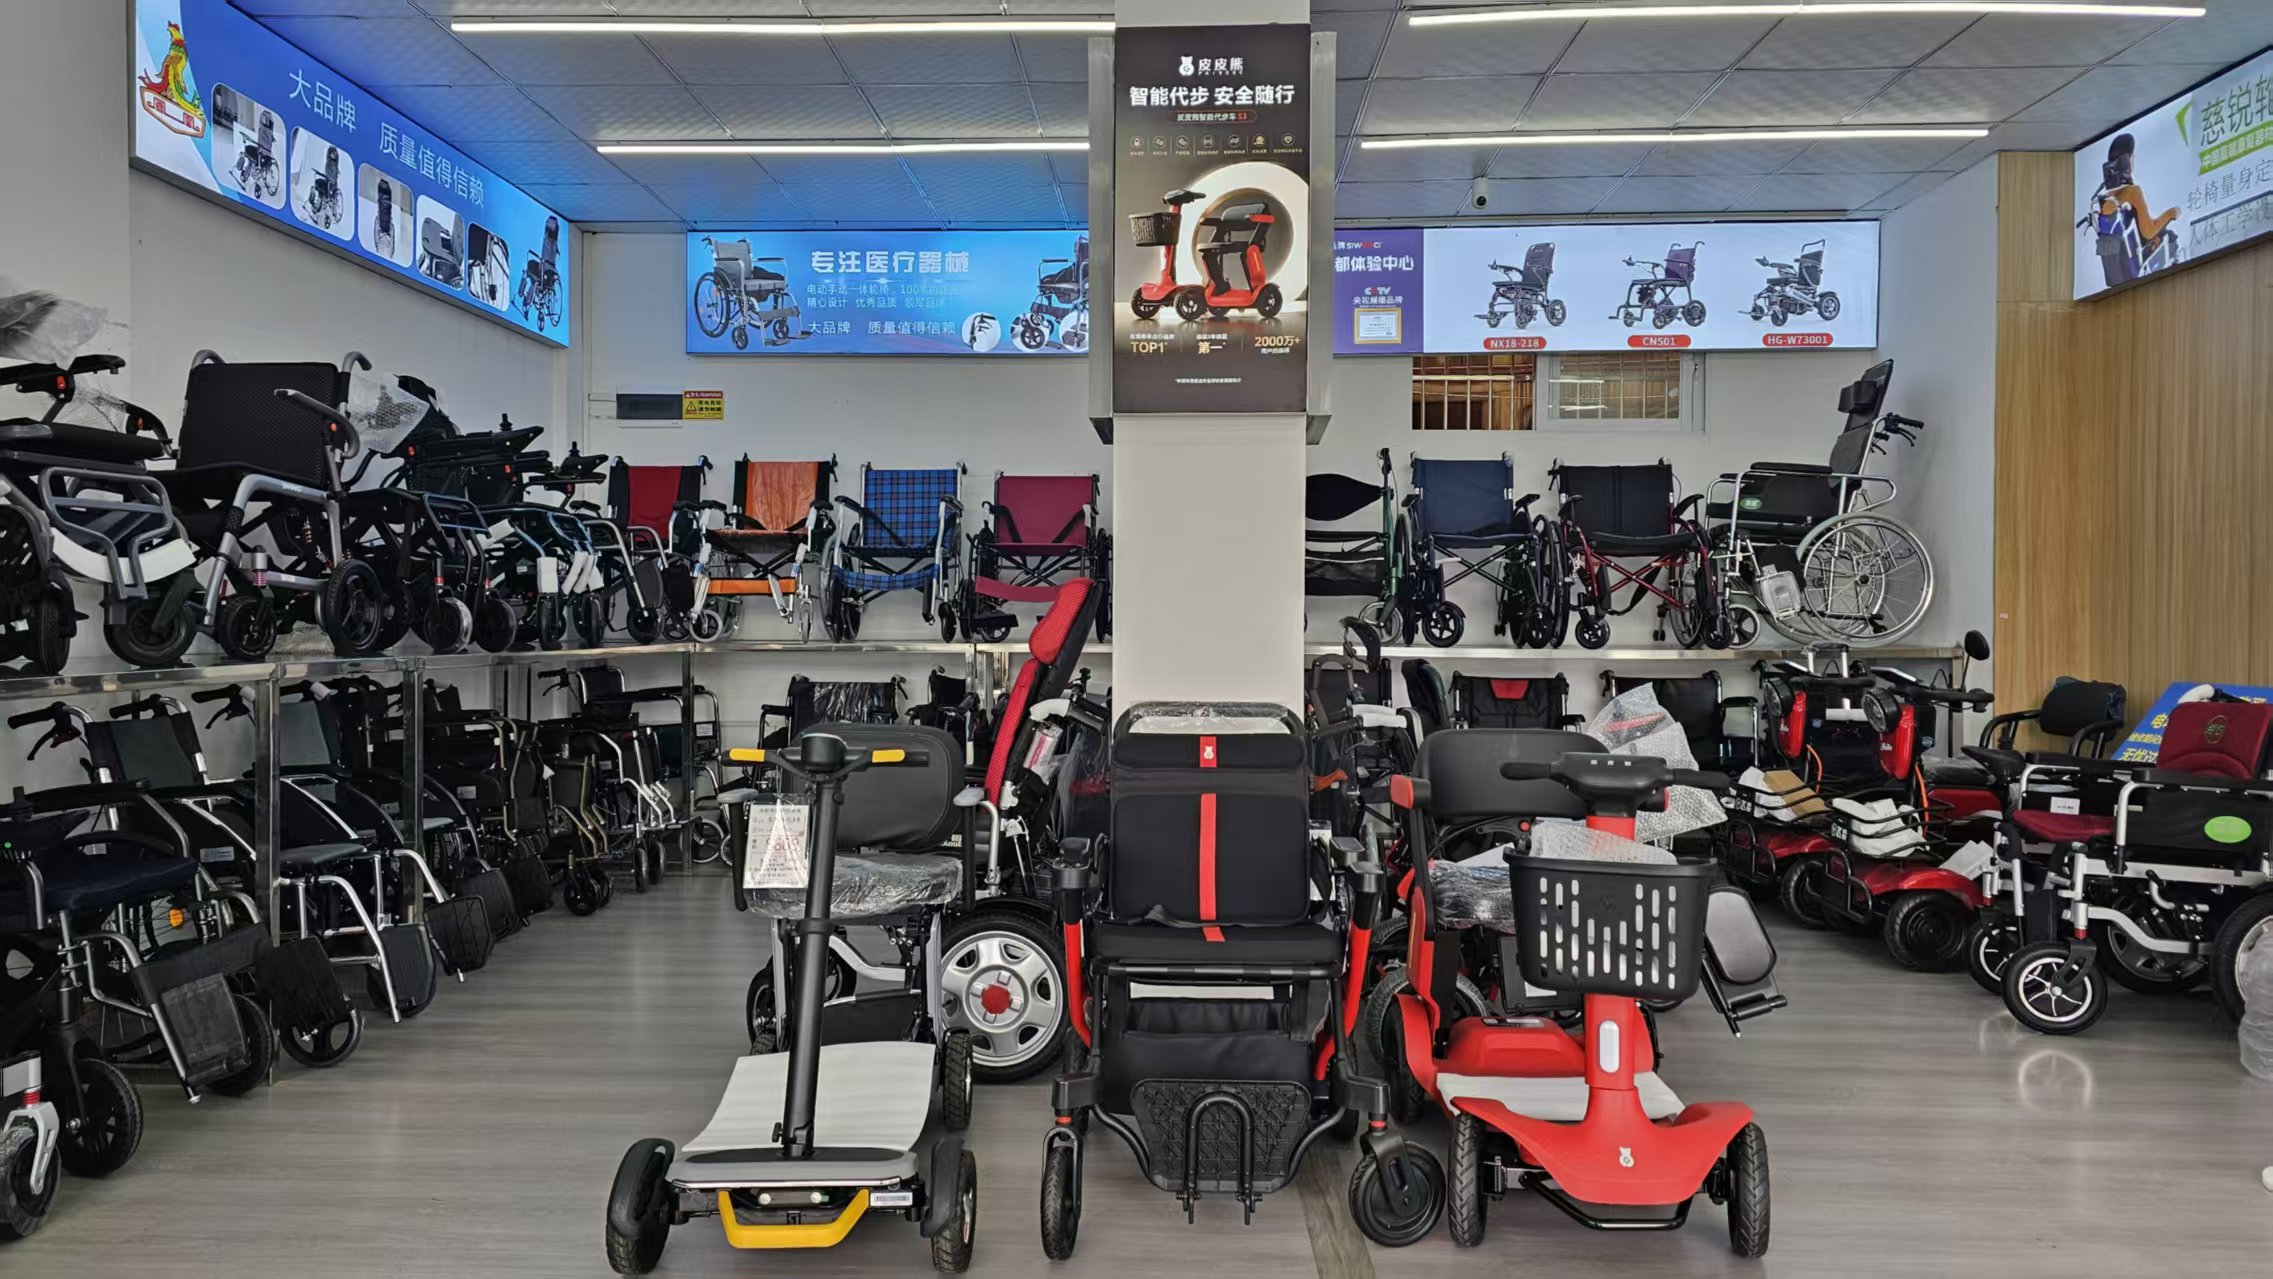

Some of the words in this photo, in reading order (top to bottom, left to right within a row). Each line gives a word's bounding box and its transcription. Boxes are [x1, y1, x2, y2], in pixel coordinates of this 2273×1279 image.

[1198, 57, 1244, 71] 皮皮熊
[1129, 86, 1210, 107] 智能代步
[1214, 84, 1296, 106] 安全随行
[288, 69, 358, 134] 大品牌
[379, 121, 485, 209] 质量值得信赖
[811, 250, 970, 273] 专注医疗器械
[1334, 255, 1415, 272] 都体验中心
[807, 298, 848, 308] 精心设计
[808, 321, 851, 335] 大品牌
[868, 321, 956, 335] 质量值得信赖
[1254, 335, 1301, 347] 2000万+
[1491, 339, 1540, 348] NX18-218
[1642, 336, 1676, 346] CN501
[1767, 335, 1829, 345] HG-W73001
